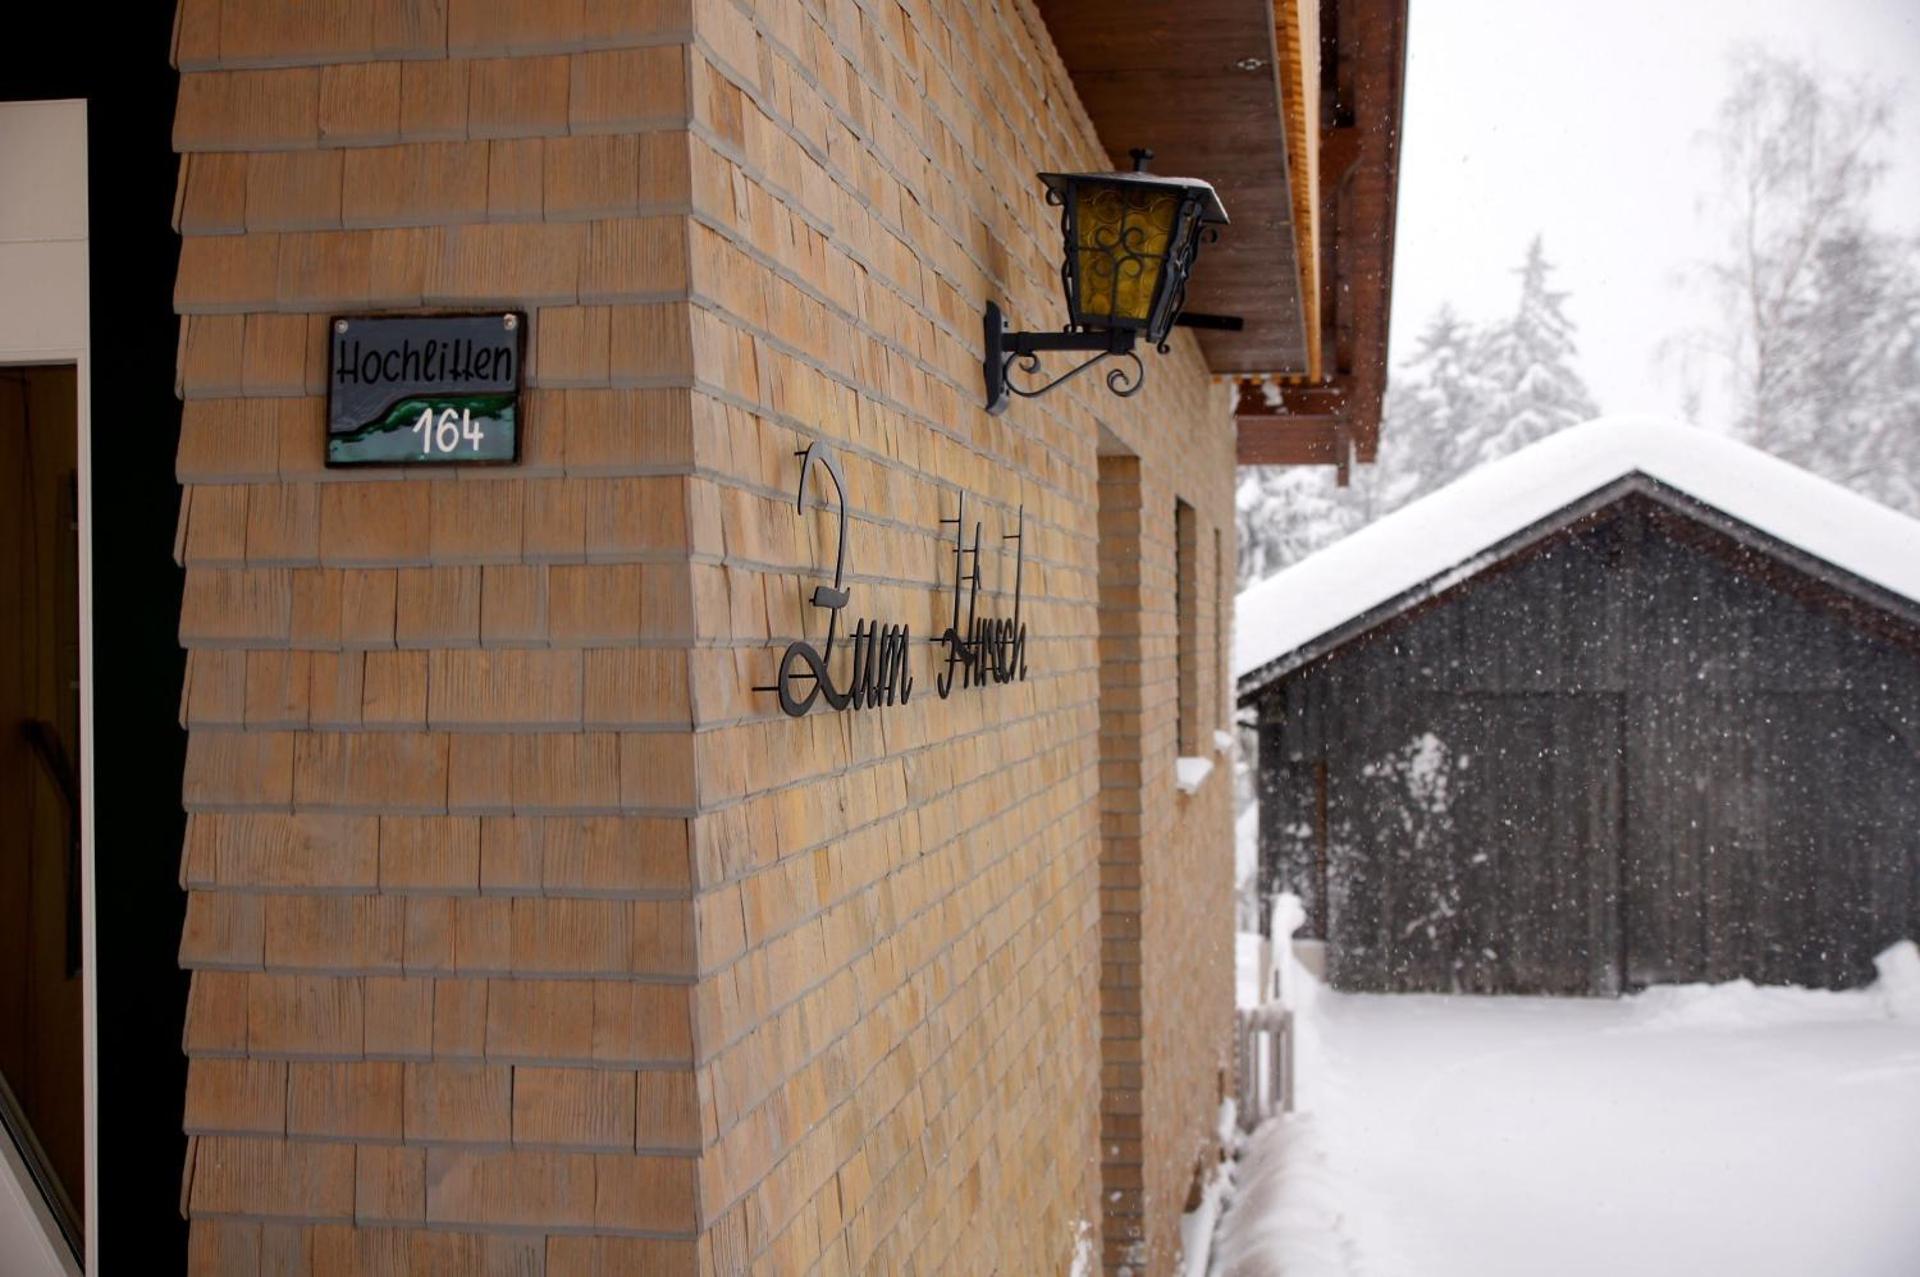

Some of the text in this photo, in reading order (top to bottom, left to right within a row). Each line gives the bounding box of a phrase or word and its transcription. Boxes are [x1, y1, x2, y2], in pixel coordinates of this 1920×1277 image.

[336, 339, 512, 384] Hochlitten
[412, 408, 485, 454] 164
[778, 441, 1028, 717] Zum Hirsch
